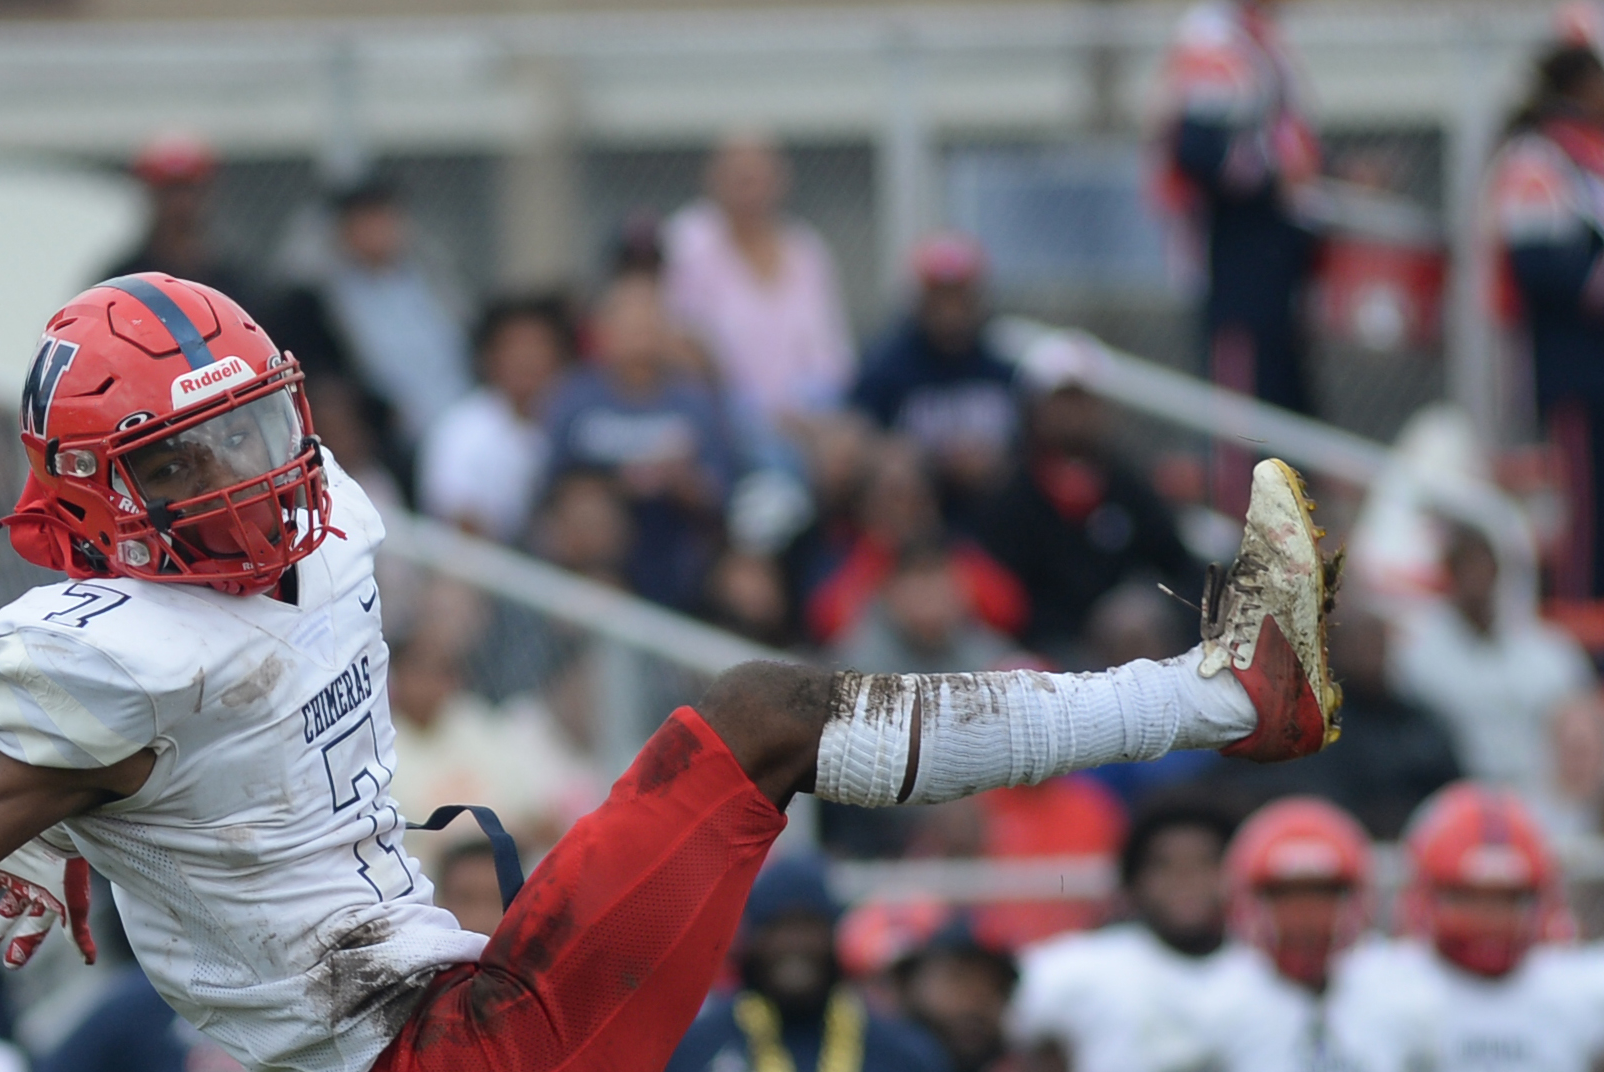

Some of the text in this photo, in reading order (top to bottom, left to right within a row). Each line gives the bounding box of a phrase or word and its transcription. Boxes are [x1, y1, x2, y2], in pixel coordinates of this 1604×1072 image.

[180, 359, 243, 394] Riddell
[42, 583, 132, 628] 7
[301, 655, 373, 744] CHIMERAS
